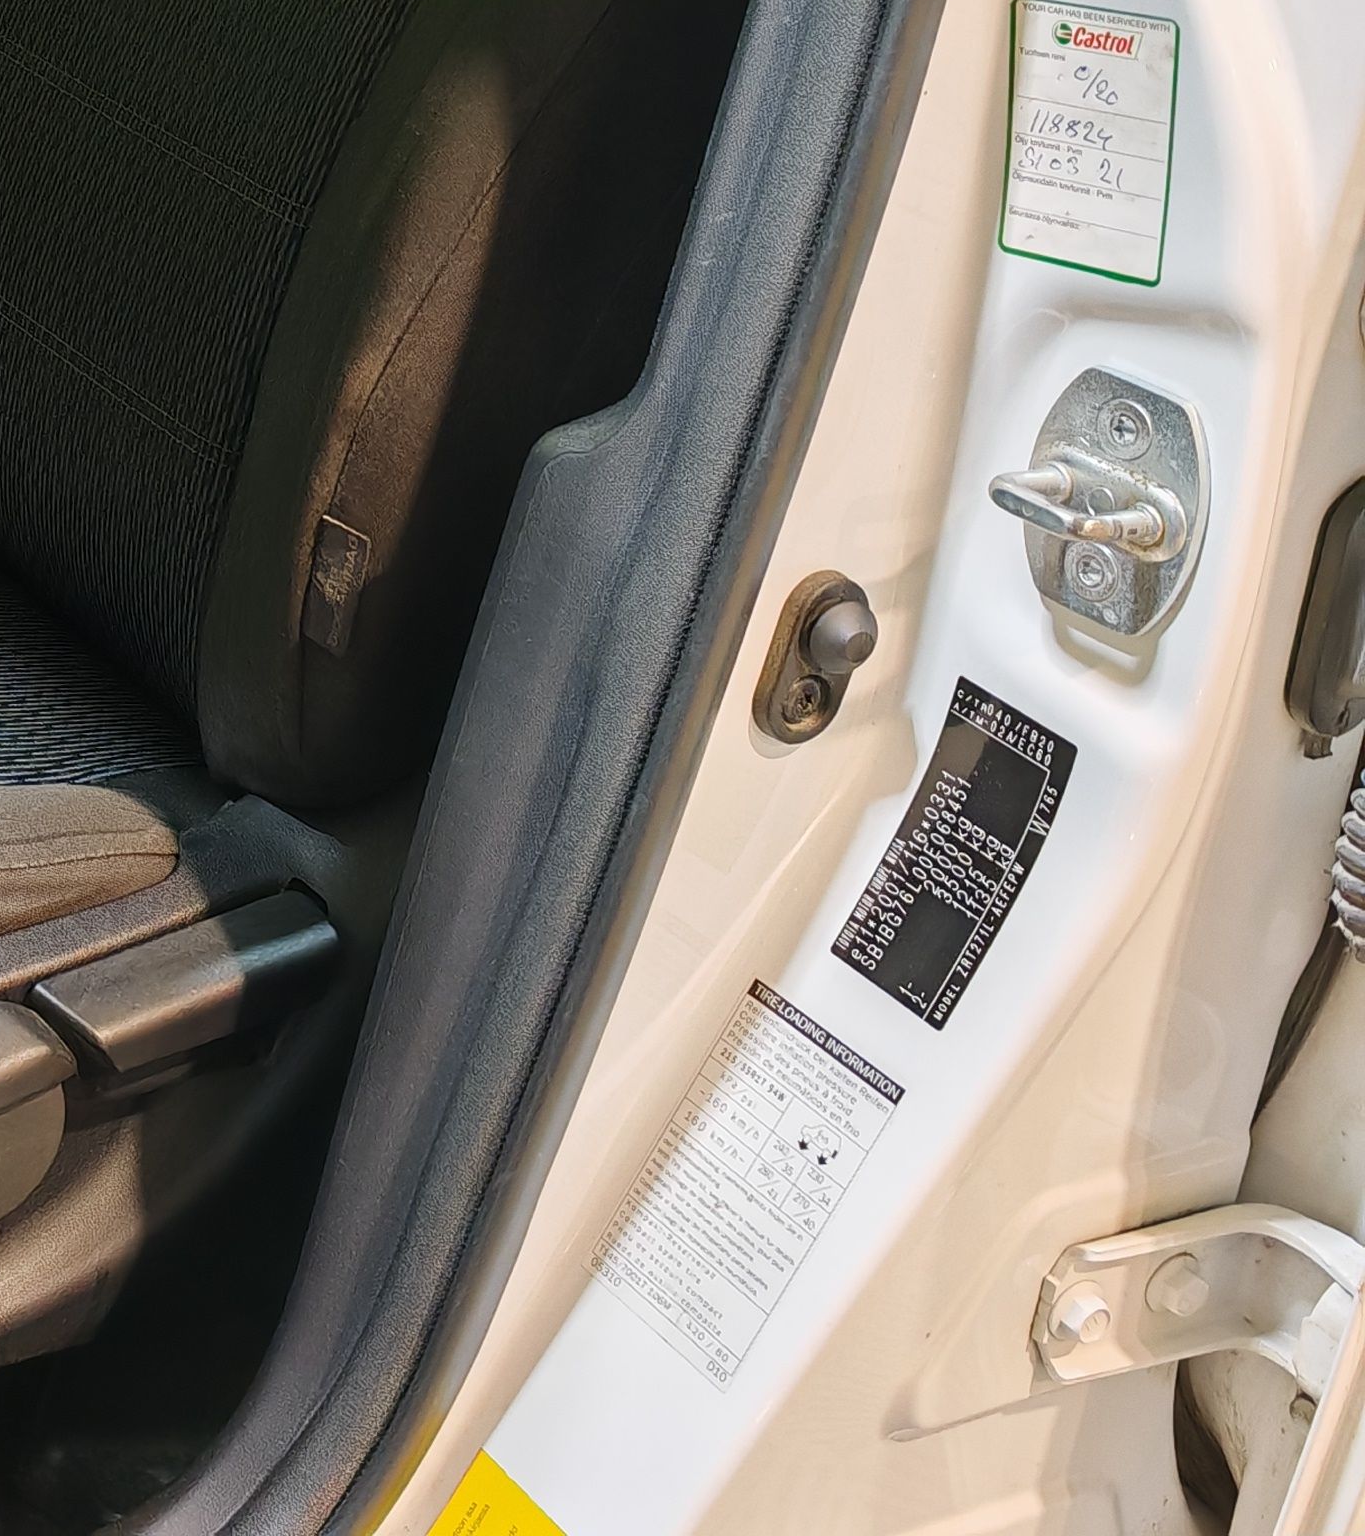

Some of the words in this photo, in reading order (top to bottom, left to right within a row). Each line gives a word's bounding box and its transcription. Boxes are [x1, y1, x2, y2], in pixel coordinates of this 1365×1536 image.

[1022, 1, 1045, 12] YOUR
[1047, 5, 1063, 15] CAR
[1065, 8, 1081, 18] HAS
[1083, 11, 1105, 22] BEEN
[1106, 15, 1146, 29] SERVICED
[1147, 21, 1170, 33] WITH
[1072, 26, 1134, 55] Castrol
[860, 776, 972, 972] SB1BG76L00E068451
[922, 840, 959, 896] 2000
[951, 814, 974, 842] kg
[936, 849, 973, 905] 3500
[964, 823, 987, 851] kg
[835, 918, 860, 951] TOYOTA
[852, 892, 875, 922] MOTOR
[868, 862, 892, 895] EUROPE
[897, 978, 915, 999] 1-
[950, 865, 985, 915] 1215
[979, 833, 1002, 861] kg
[910, 988, 929, 1010] 2-
[964, 875, 998, 924] 1135
[993, 842, 1016, 870] kg
[932, 981, 960, 1021] MODEL
[955, 861, 1024, 978] ZRT271L-AEFEPW
[737, 1009, 761, 1030] Cold
[753, 983, 826, 1044] TIRE-LOADING
[824, 1037, 901, 1100] INFORMATION
[683, 1109, 708, 1133] 160
[589, 1255, 622, 1288] 05310
[706, 1360, 727, 1383] D10
